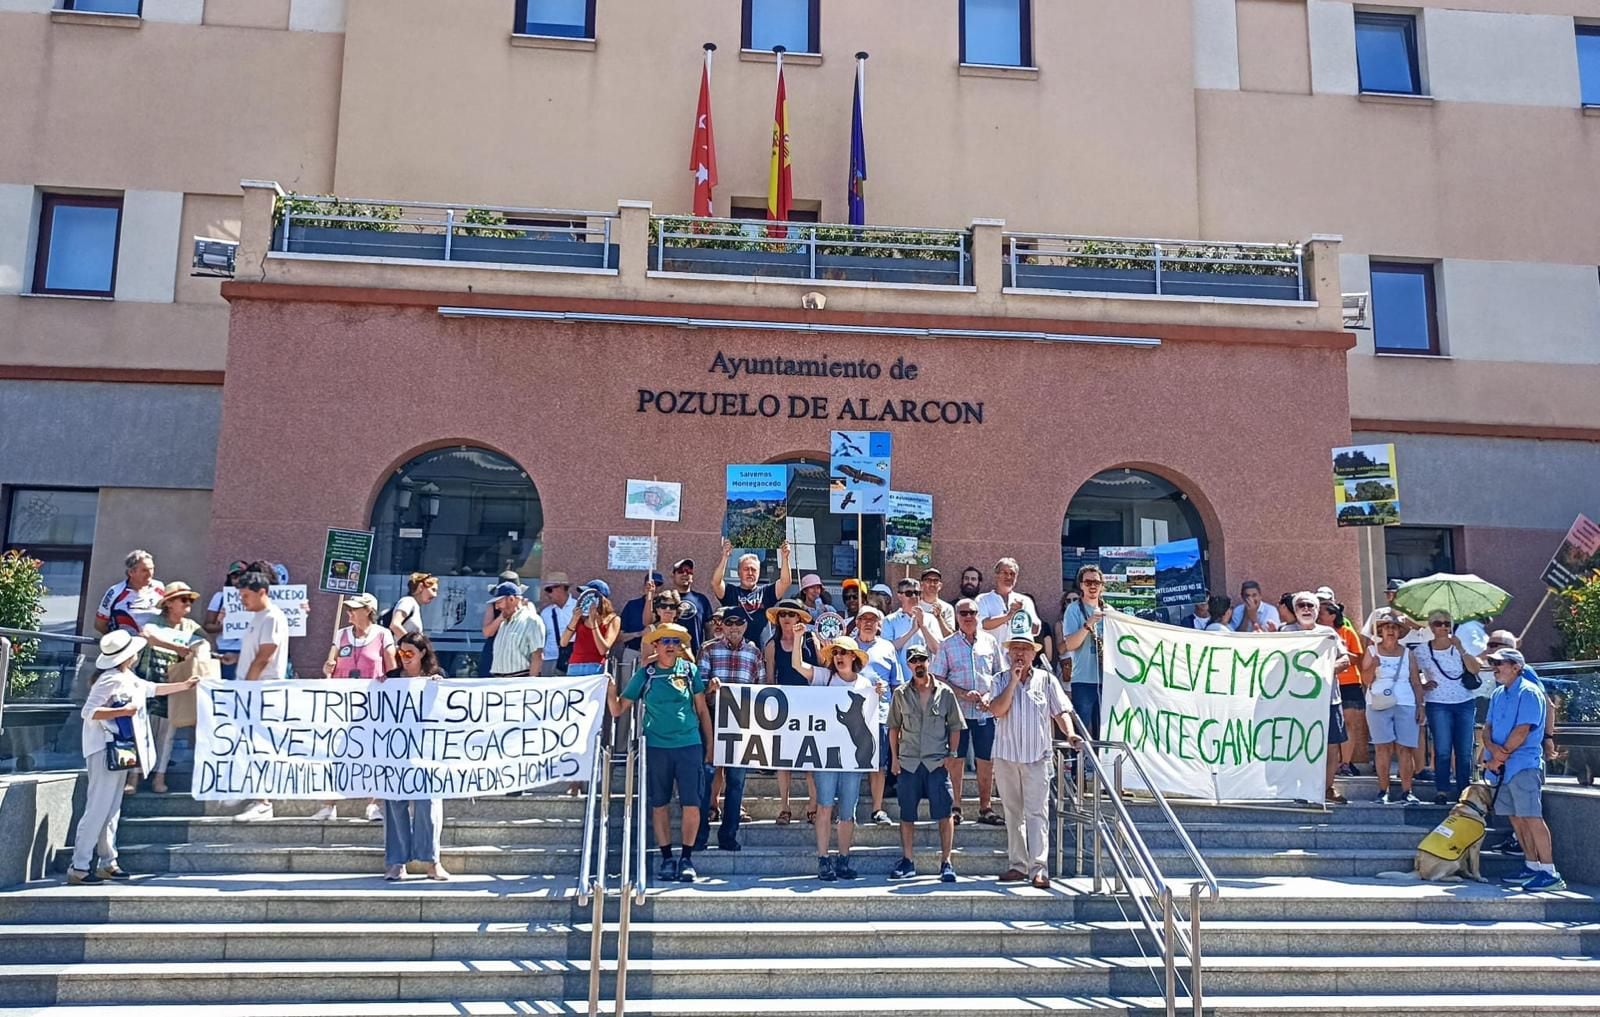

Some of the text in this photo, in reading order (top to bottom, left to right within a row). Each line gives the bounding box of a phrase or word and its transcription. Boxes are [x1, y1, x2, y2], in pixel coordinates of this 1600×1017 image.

[708, 351, 918, 380] Ayuntamiento de
[638, 389, 984, 425] POZUELO DE ALARCON
[732, 480, 782, 488] Montegancedo
[1114, 634, 1323, 700] SALVEMOS
[211, 689, 586, 723] EN EL TRIBUNAL SUPERIOR
[718, 686, 827, 732] NO a la
[211, 722, 580, 762] SALVEMOS MONTEGACEDO
[718, 733, 823, 769] TALA
[1105, 704, 1325, 766] MONTEGANCEDO
[518, 751, 580, 787] HOMES
